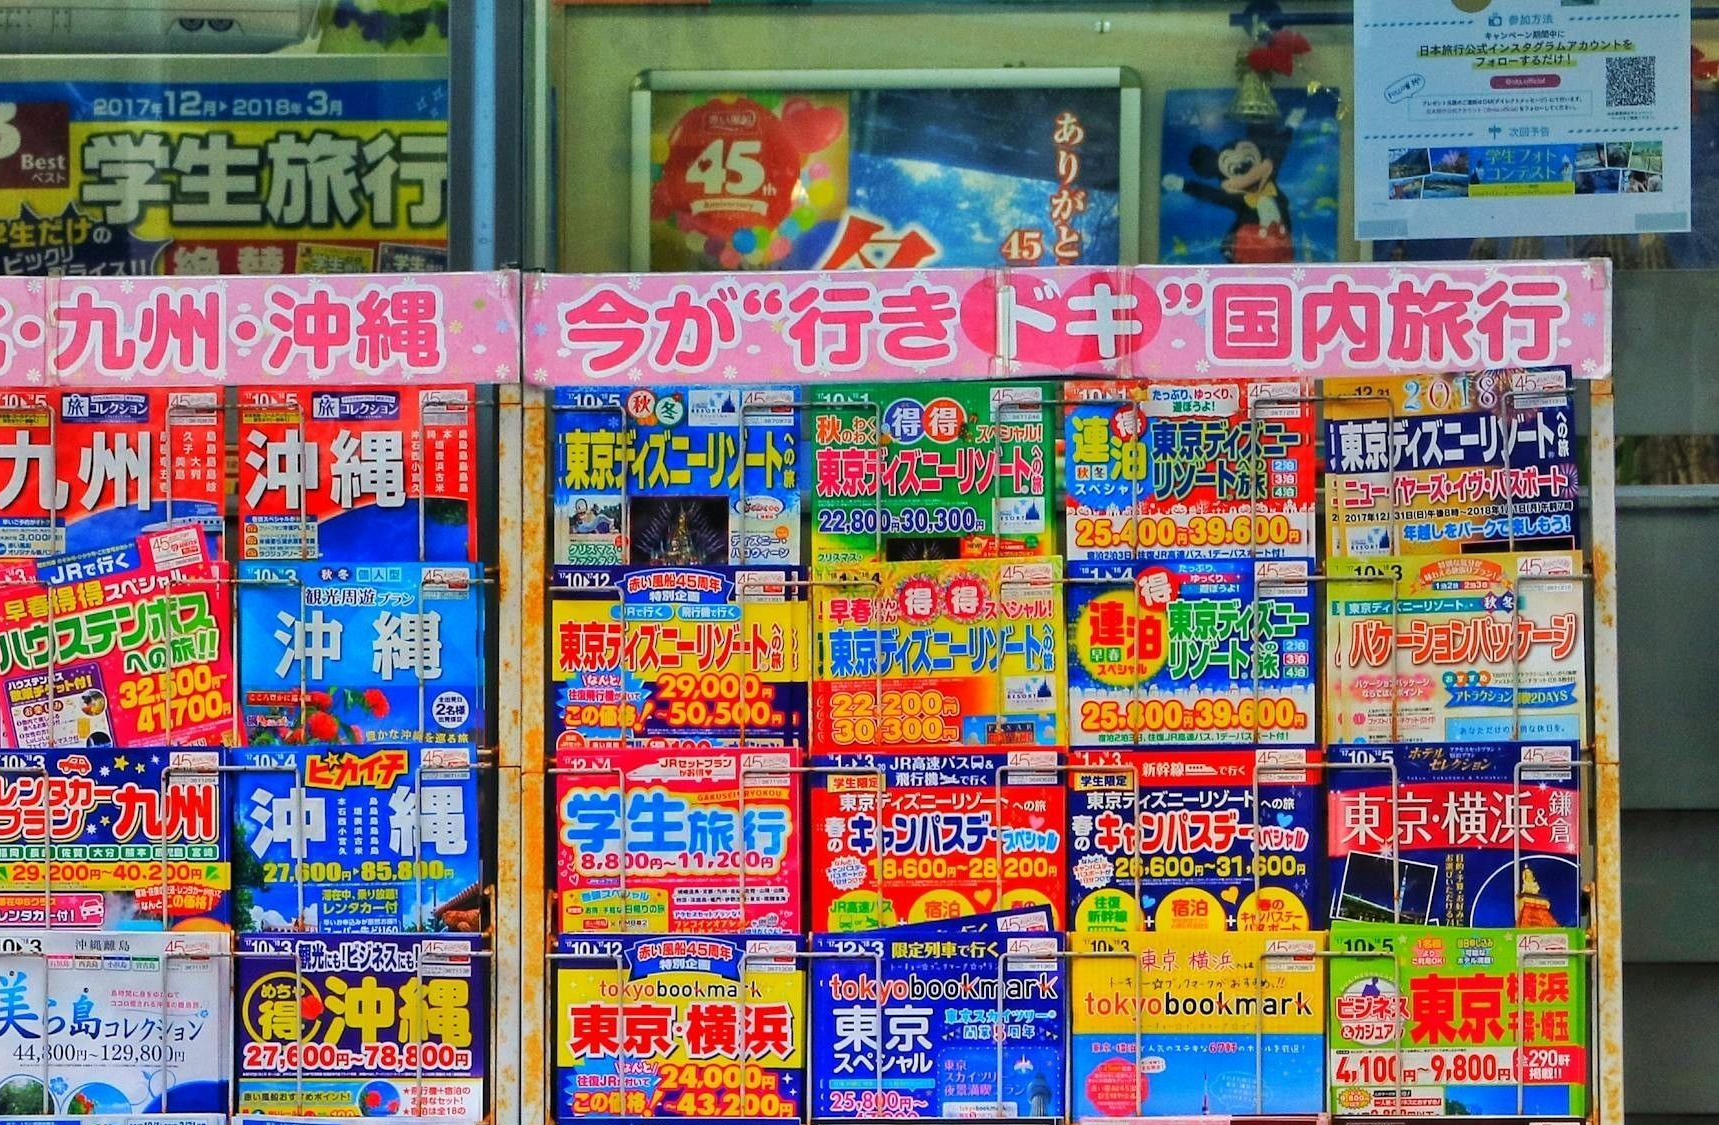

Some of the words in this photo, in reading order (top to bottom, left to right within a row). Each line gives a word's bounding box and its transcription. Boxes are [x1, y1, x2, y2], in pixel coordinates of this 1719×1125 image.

[1509, 13, 1553, 25] 参加方法
[1477, 54, 1571, 67] フォローするだけ!
[93, 90, 218, 117] 2017年12月
[233, 90, 343, 117] 2018年3月
[1509, 126, 1550, 137] 次回予告
[20, 154, 66, 173] Best
[686, 139, 765, 196] 45
[1485, 166, 1557, 180] コンテスト
[80, 131, 448, 226] 学生旅行
[1051, 113, 1085, 258] ありがと
[1002, 231, 1044, 261] 45
[1339, 410, 1555, 471] 東京ディズニーリゾート
[244, 429, 406, 509] 沖縄
[783, 431, 795, 489] への旅
[816, 448, 1029, 497] 東京ディズニーリゾート
[1273, 460, 1296, 472] 2泊
[1273, 474, 1296, 485] 3泊
[50, 552, 130, 585] JRで行く
[305, 587, 415, 607] 観光周遊プラン
[627, 573, 722, 594] 赤い風船45周年
[649, 591, 700, 603] 特別企画
[273, 610, 442, 680] 沖縄
[830, 628, 1042, 677] 東京ディズニーリゾート
[1091, 646, 1121, 661] 早春
[1348, 614, 1577, 669] バケーションパッケージ
[658, 757, 732, 770] JRセットプラン
[1142, 762, 1185, 777] 新幹線
[1409, 749, 1443, 762] ホテル
[305, 750, 409, 791] ピカイチ
[112, 784, 219, 841] 九州
[1013, 798, 1047, 812] への旅
[1547, 793, 1571, 844] 鎌倉
[566, 791, 787, 857] 学生旅行
[323, 901, 400, 915] レンタカー付
[924, 900, 962, 919] 宿泊
[1172, 899, 1209, 917] 宿泊
[75, 938, 130, 951] 沖縄離島
[892, 941, 998, 958] 限定列車で行く
[658, 959, 711, 971] 特別企画
[1506, 974, 1569, 1003] 横浜
[323, 975, 472, 1049] 沖縄
[1085, 990, 1312, 1022] tokyobookmark
[1410, 975, 1504, 1044] 東京
[569, 1003, 793, 1059] 東京・横浜
[832, 1006, 933, 1051] 東京
